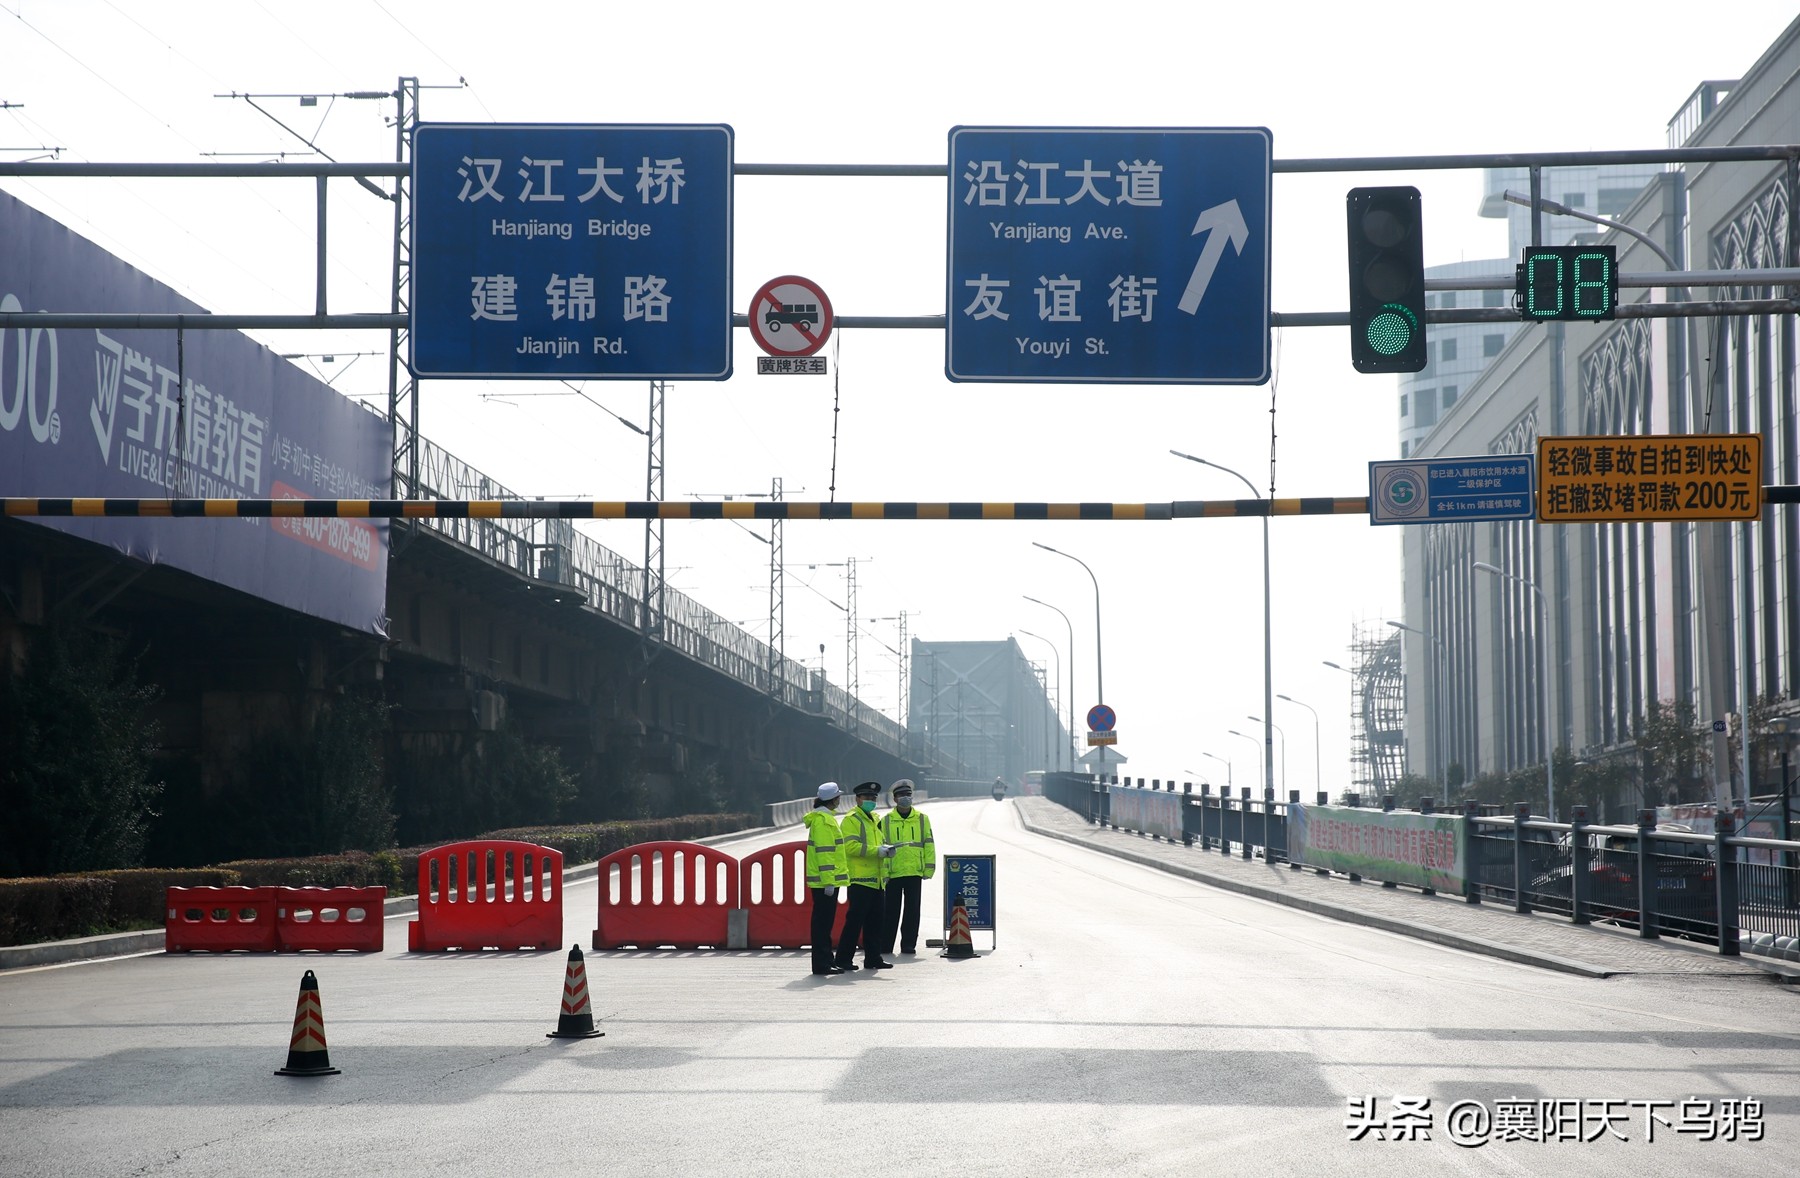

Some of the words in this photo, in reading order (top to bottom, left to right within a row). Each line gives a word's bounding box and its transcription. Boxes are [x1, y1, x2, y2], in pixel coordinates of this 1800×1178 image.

[457, 155, 686, 205] 汉江大桥
[963, 159, 1164, 207] 沿江大道
[492, 219, 573, 240] Hanjiang
[588, 219, 651, 240] Bridge
[989, 222, 1071, 243] Yanjiang
[1084, 222, 1128, 240] Ave.
[471, 273, 672, 323] 建锦路
[963, 273, 1157, 323] 友谊街
[1528, 253, 1609, 316] 08
[516, 336, 580, 359] Jianjin
[594, 337, 628, 355] Rd.
[1015, 337, 1070, 359] Youyi
[1084, 337, 1109, 355] St.
[760, 358, 824, 373] 黄牌货车
[1430, 465, 1527, 479] 您已进入襄阳市饮用水水源
[1548, 444, 1751, 477] 轻微事故自拍到快处
[1457, 478, 1502, 489] 二级保护区
[1547, 481, 1750, 514] 拒撤致堵罚款200元
[962, 863, 979, 918] 公安检查点
